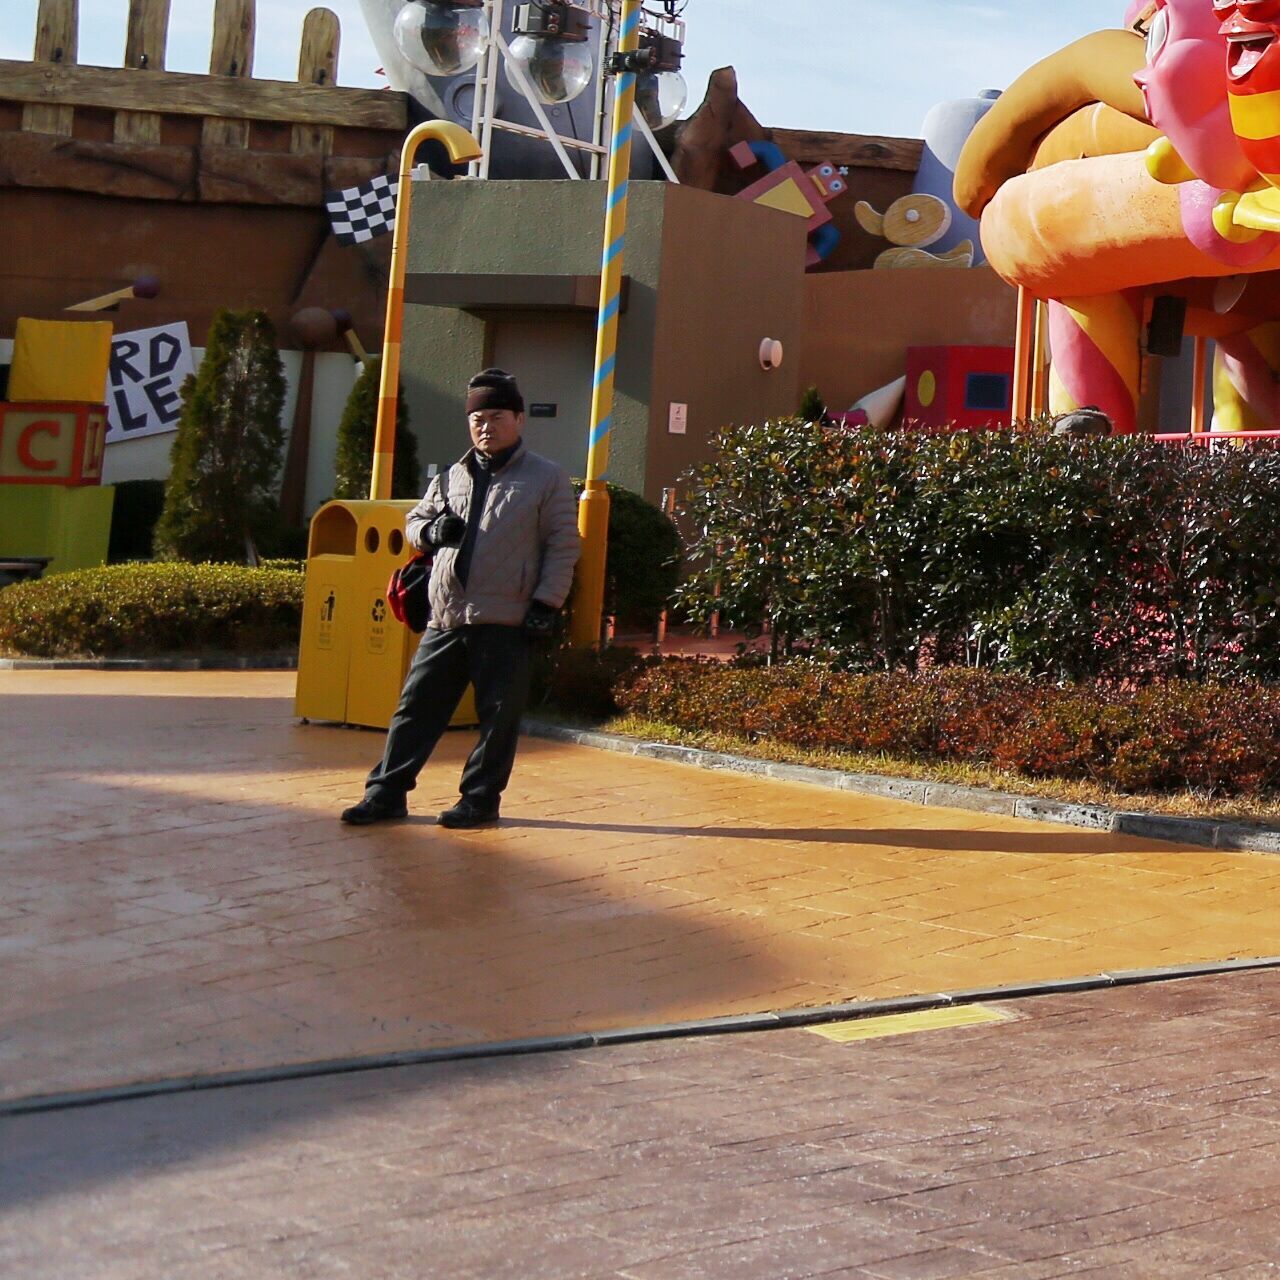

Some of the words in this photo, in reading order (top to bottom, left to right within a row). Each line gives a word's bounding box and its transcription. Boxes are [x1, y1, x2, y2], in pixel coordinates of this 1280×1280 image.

[110, 332, 182, 387] RD
[105, 376, 182, 432] LE
[17, 421, 61, 471] C
